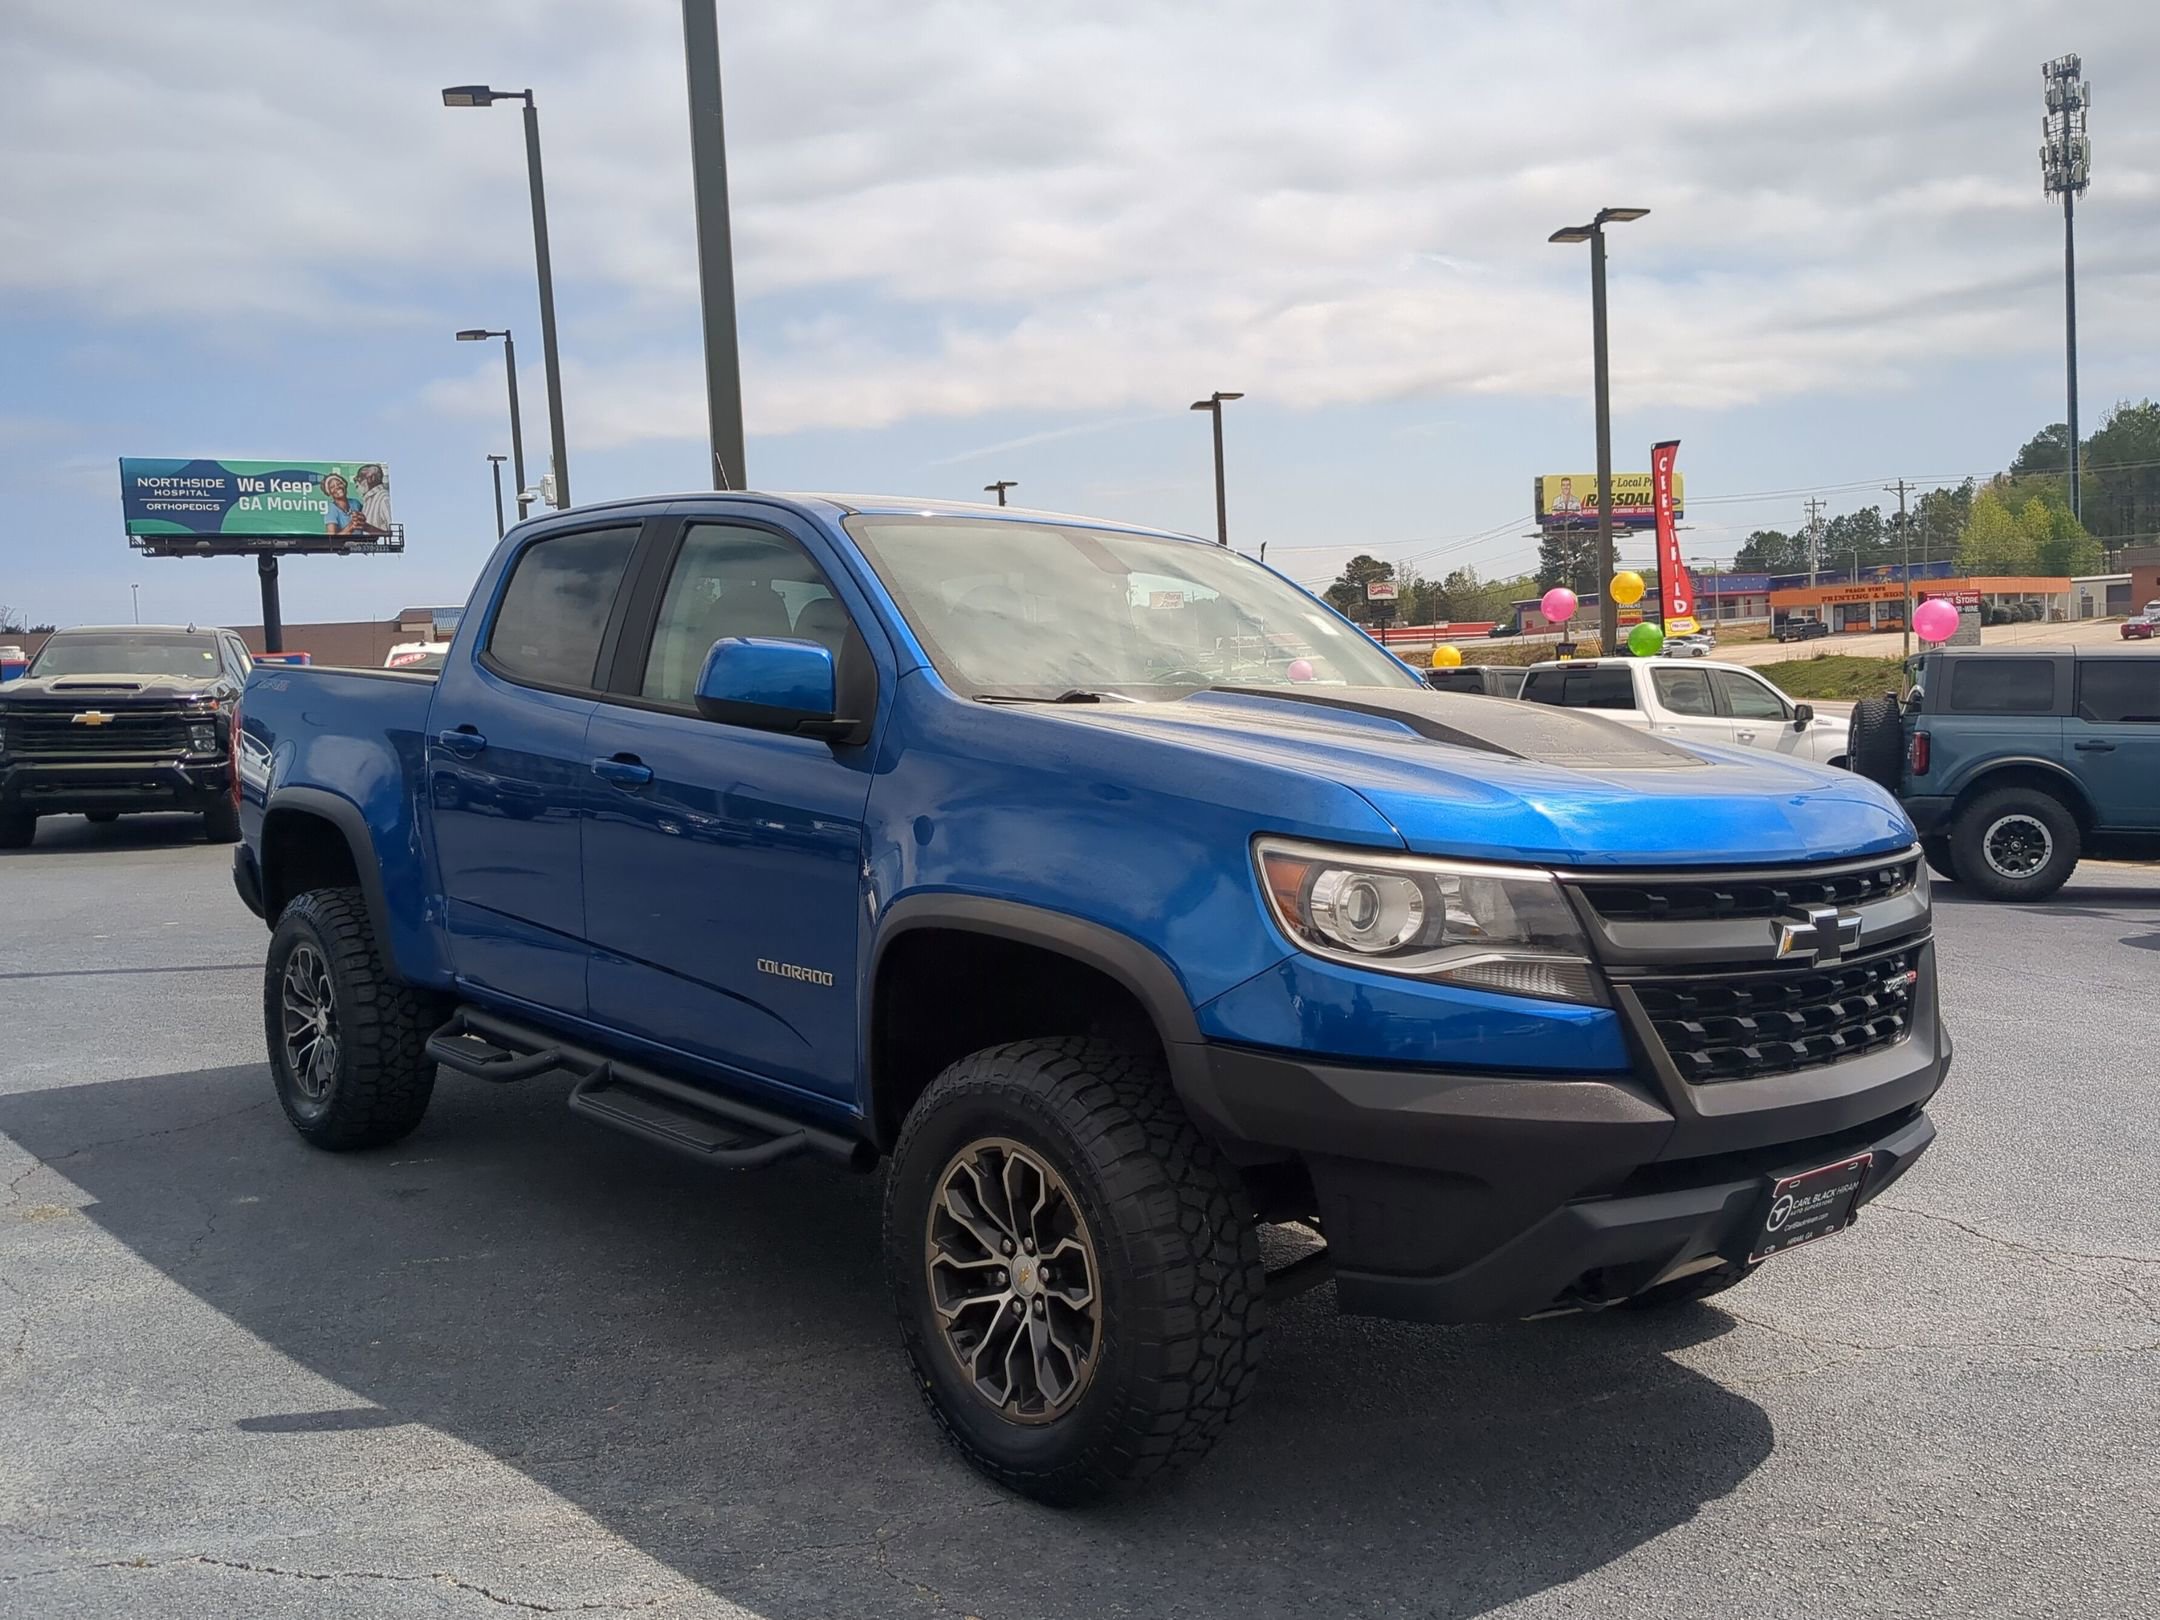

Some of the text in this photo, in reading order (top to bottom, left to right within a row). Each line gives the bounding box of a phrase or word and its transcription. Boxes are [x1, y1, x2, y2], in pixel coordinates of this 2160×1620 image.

[137, 477, 225, 489] NORTHSIDE
[237, 478, 312, 495] We Keep
[1618, 476, 1641, 488] Local
[154, 489, 210, 497] HOSPITAL
[146, 503, 220, 511] ORTHOPEDICS
[239, 497, 329, 515] GA Moving
[1821, 593, 1869, 602] PRINTING
[757, 958, 833, 987] COLORADO
[1793, 1196, 1811, 1209] CARL
[1812, 1188, 1838, 1203] BLACK
